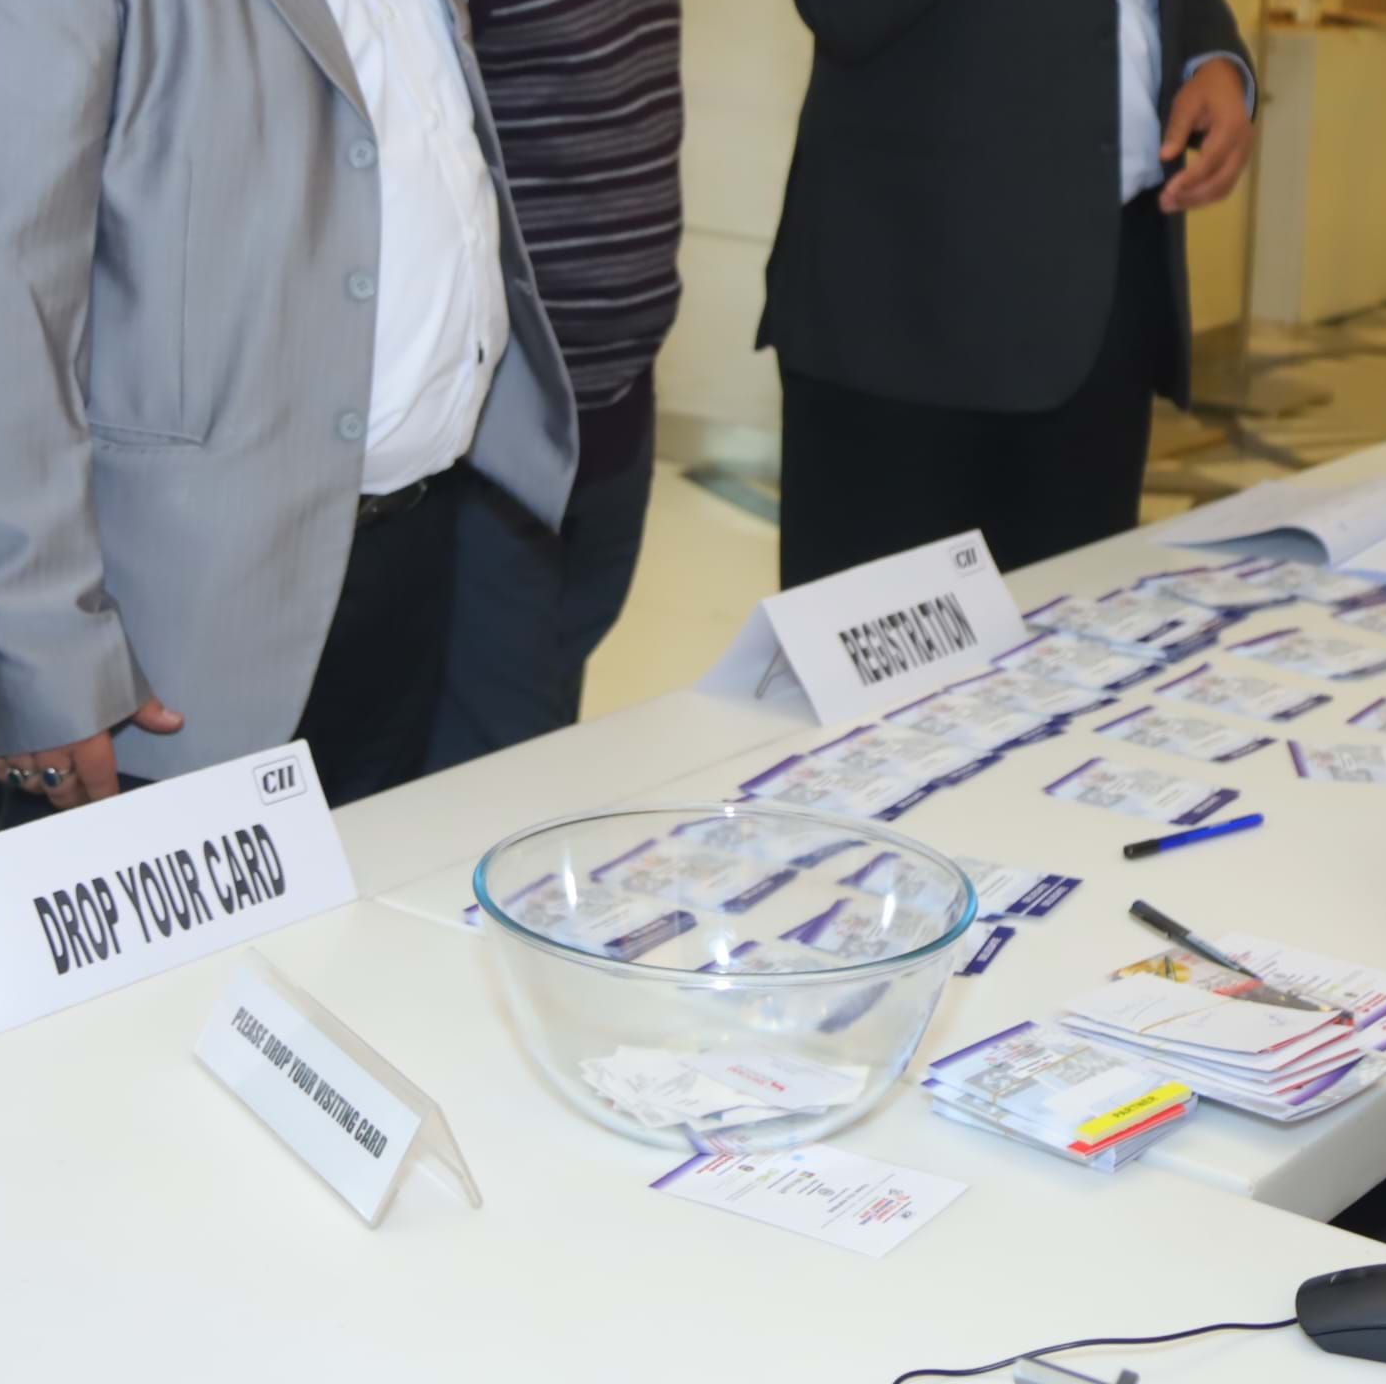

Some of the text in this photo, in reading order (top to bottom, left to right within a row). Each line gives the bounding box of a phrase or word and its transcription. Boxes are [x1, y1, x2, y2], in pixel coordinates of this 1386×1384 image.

[955, 547, 978, 569] CII
[838, 591, 978, 686] REGISTRATION
[263, 764, 295, 794] CII
[33, 823, 286, 975] DROP YOUR CARD
[230, 1005, 388, 1160] PLEASE DROP YOUR VISITING CARD
